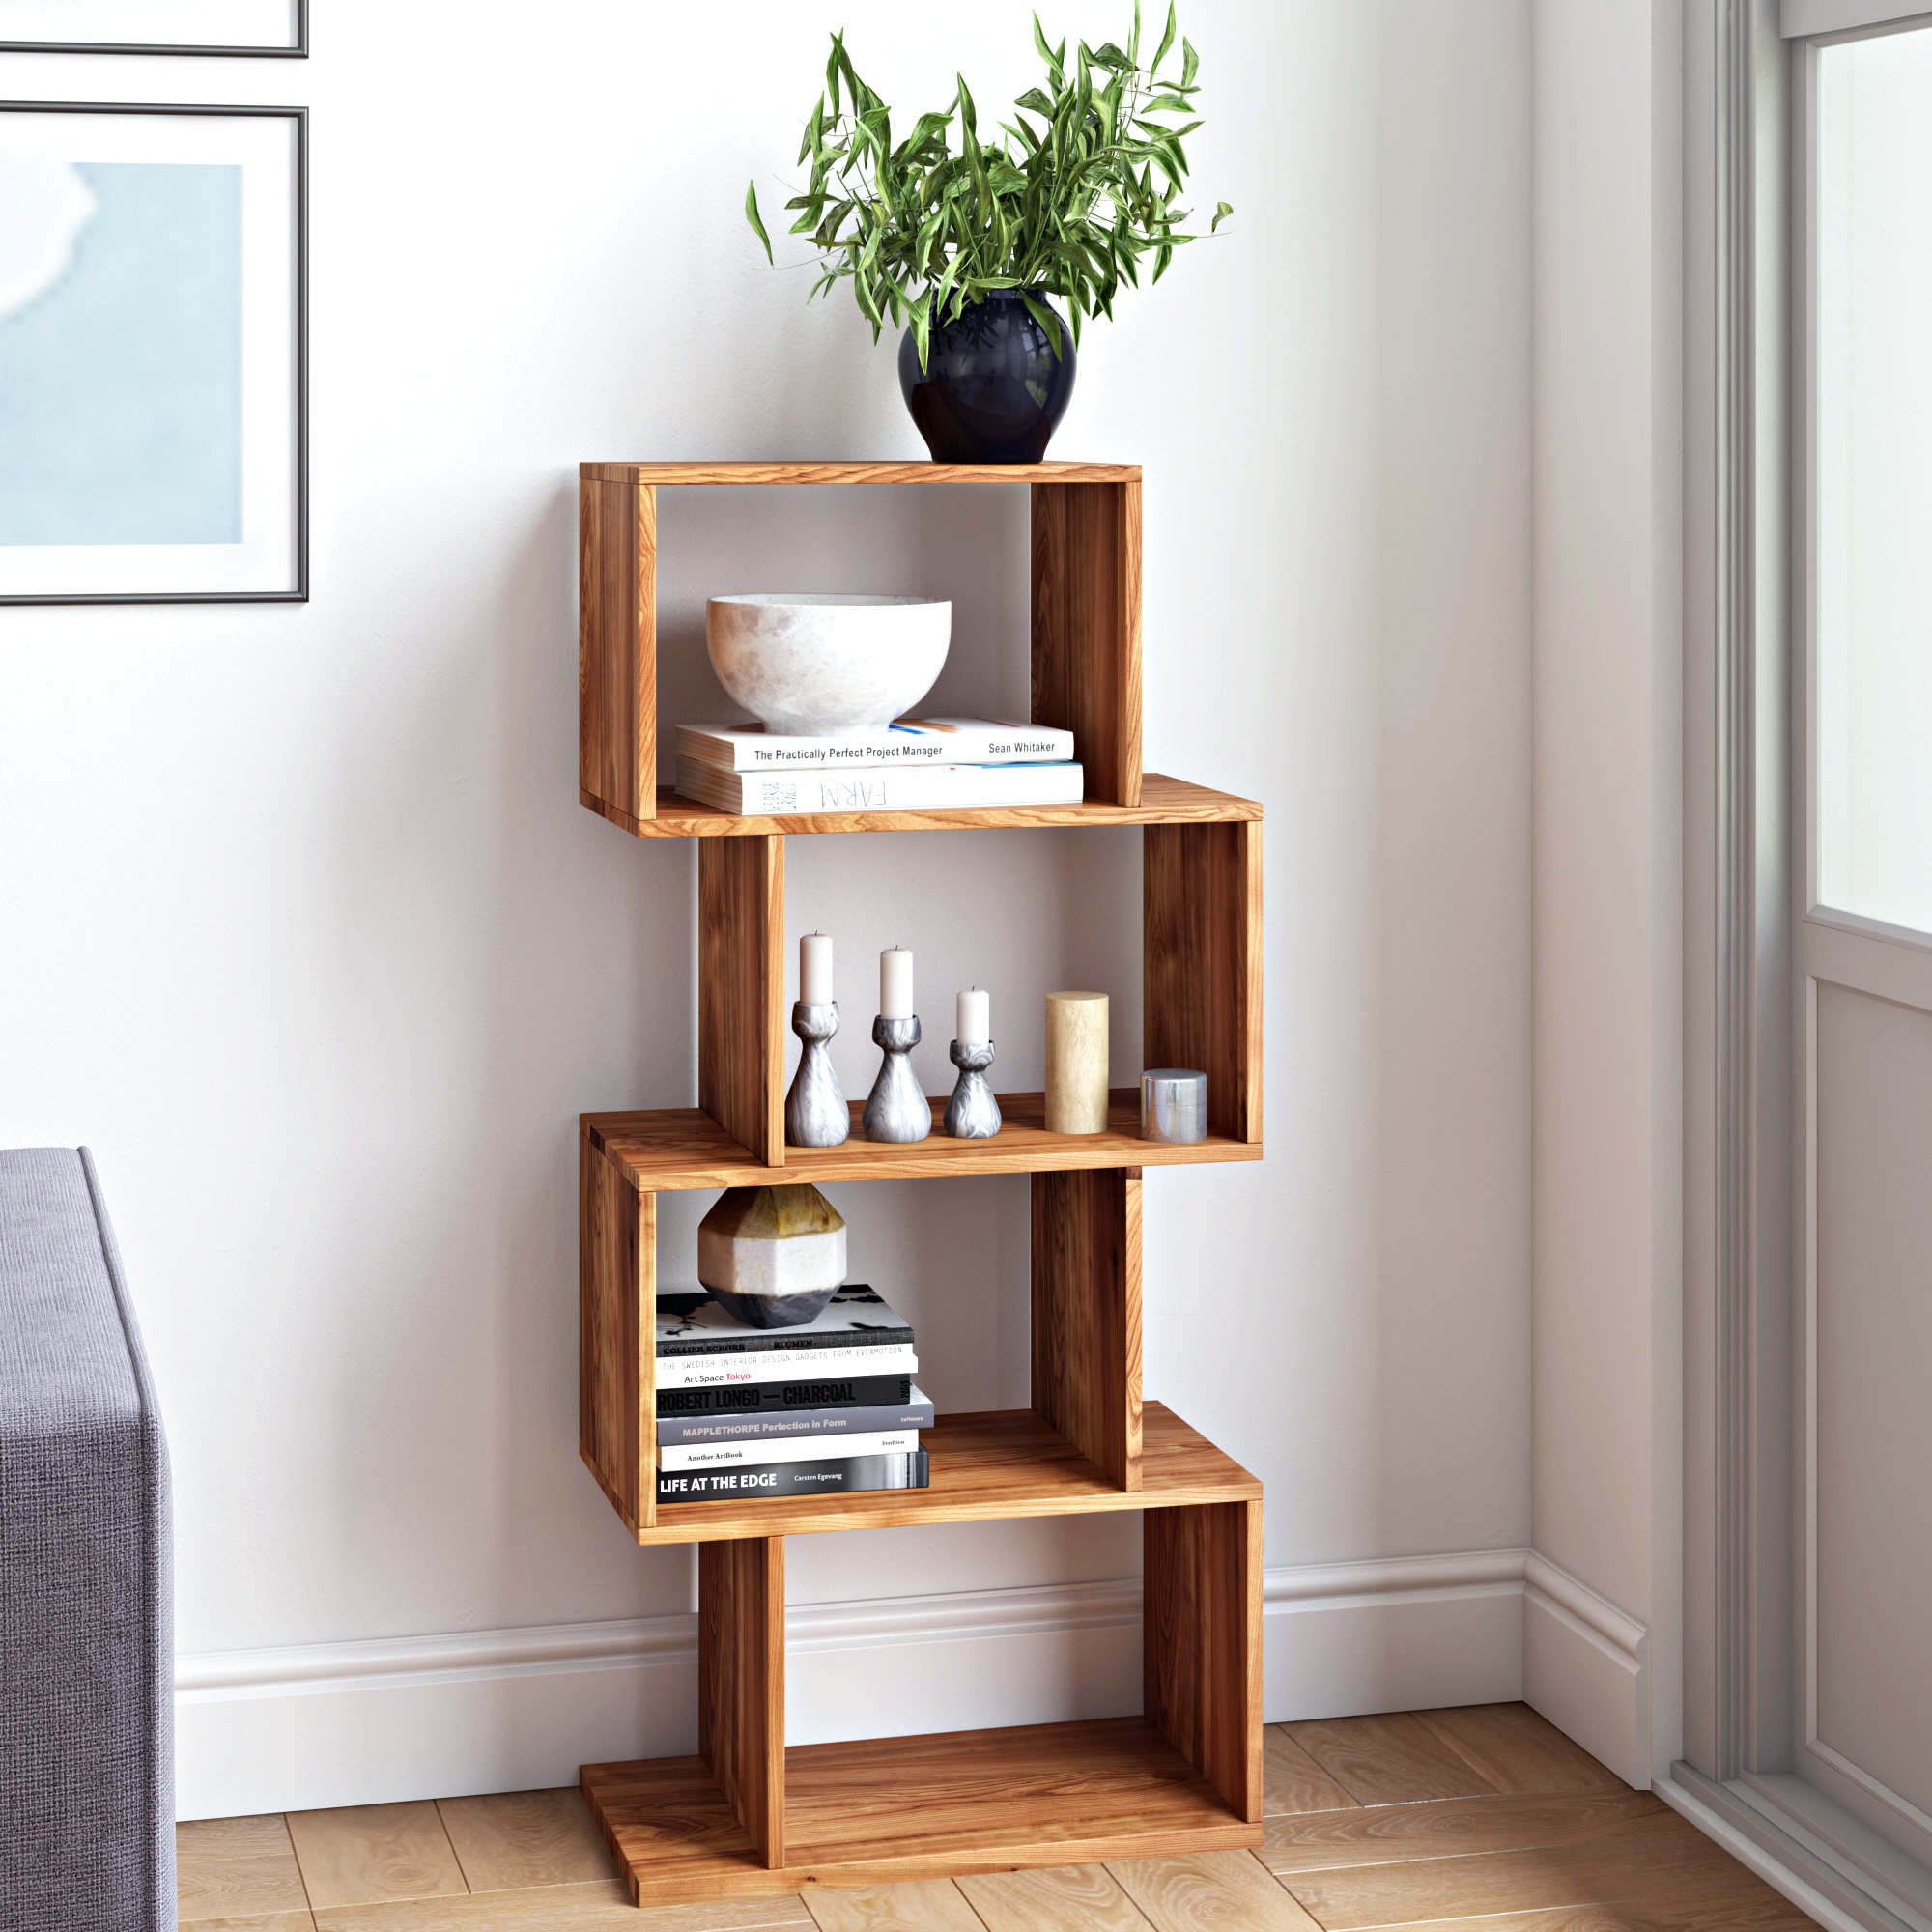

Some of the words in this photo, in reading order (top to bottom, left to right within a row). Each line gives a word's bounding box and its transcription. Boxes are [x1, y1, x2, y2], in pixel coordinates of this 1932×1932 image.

[755, 750, 772, 760] The
[776, 748, 826, 761] Practically
[829, 747, 863, 758] Perfect
[866, 746, 900, 759] Project
[903, 746, 943, 758] Manager
[989, 743, 1011, 753] Sean
[1014, 742, 1055, 752] Whitaker
[663, 1345, 704, 1355] COLLIER
[706, 1343, 745, 1353] SCHORR
[774, 1339, 812, 1349] BLUMEN
[682, 1359, 715, 1369] SWEDISH
[720, 1356, 757, 1367] INTERIOR
[763, 1354, 791, 1364] DESIGN
[796, 1352, 828, 1361] GADGETS
[700, 1375, 724, 1383] Space
[726, 1372, 751, 1382] Tokyo
[656, 1391, 712, 1412] ROBERT
[716, 1389, 761, 1409] LONGO
[783, 1383, 856, 1405] CHARCOAL
[682, 1423, 760, 1437] MAPPLETHORPE
[763, 1421, 810, 1432] Perfection
[812, 1420, 821, 1429] in
[823, 1419, 847, 1428] Form
[687, 1453, 714, 1462] Another
[715, 1451, 743, 1460] ArtBook
[660, 1479, 688, 1493] LIFE
[691, 1477, 708, 1491] AT
[710, 1476, 737, 1489] THE
[740, 1473, 777, 1488] EDGE
